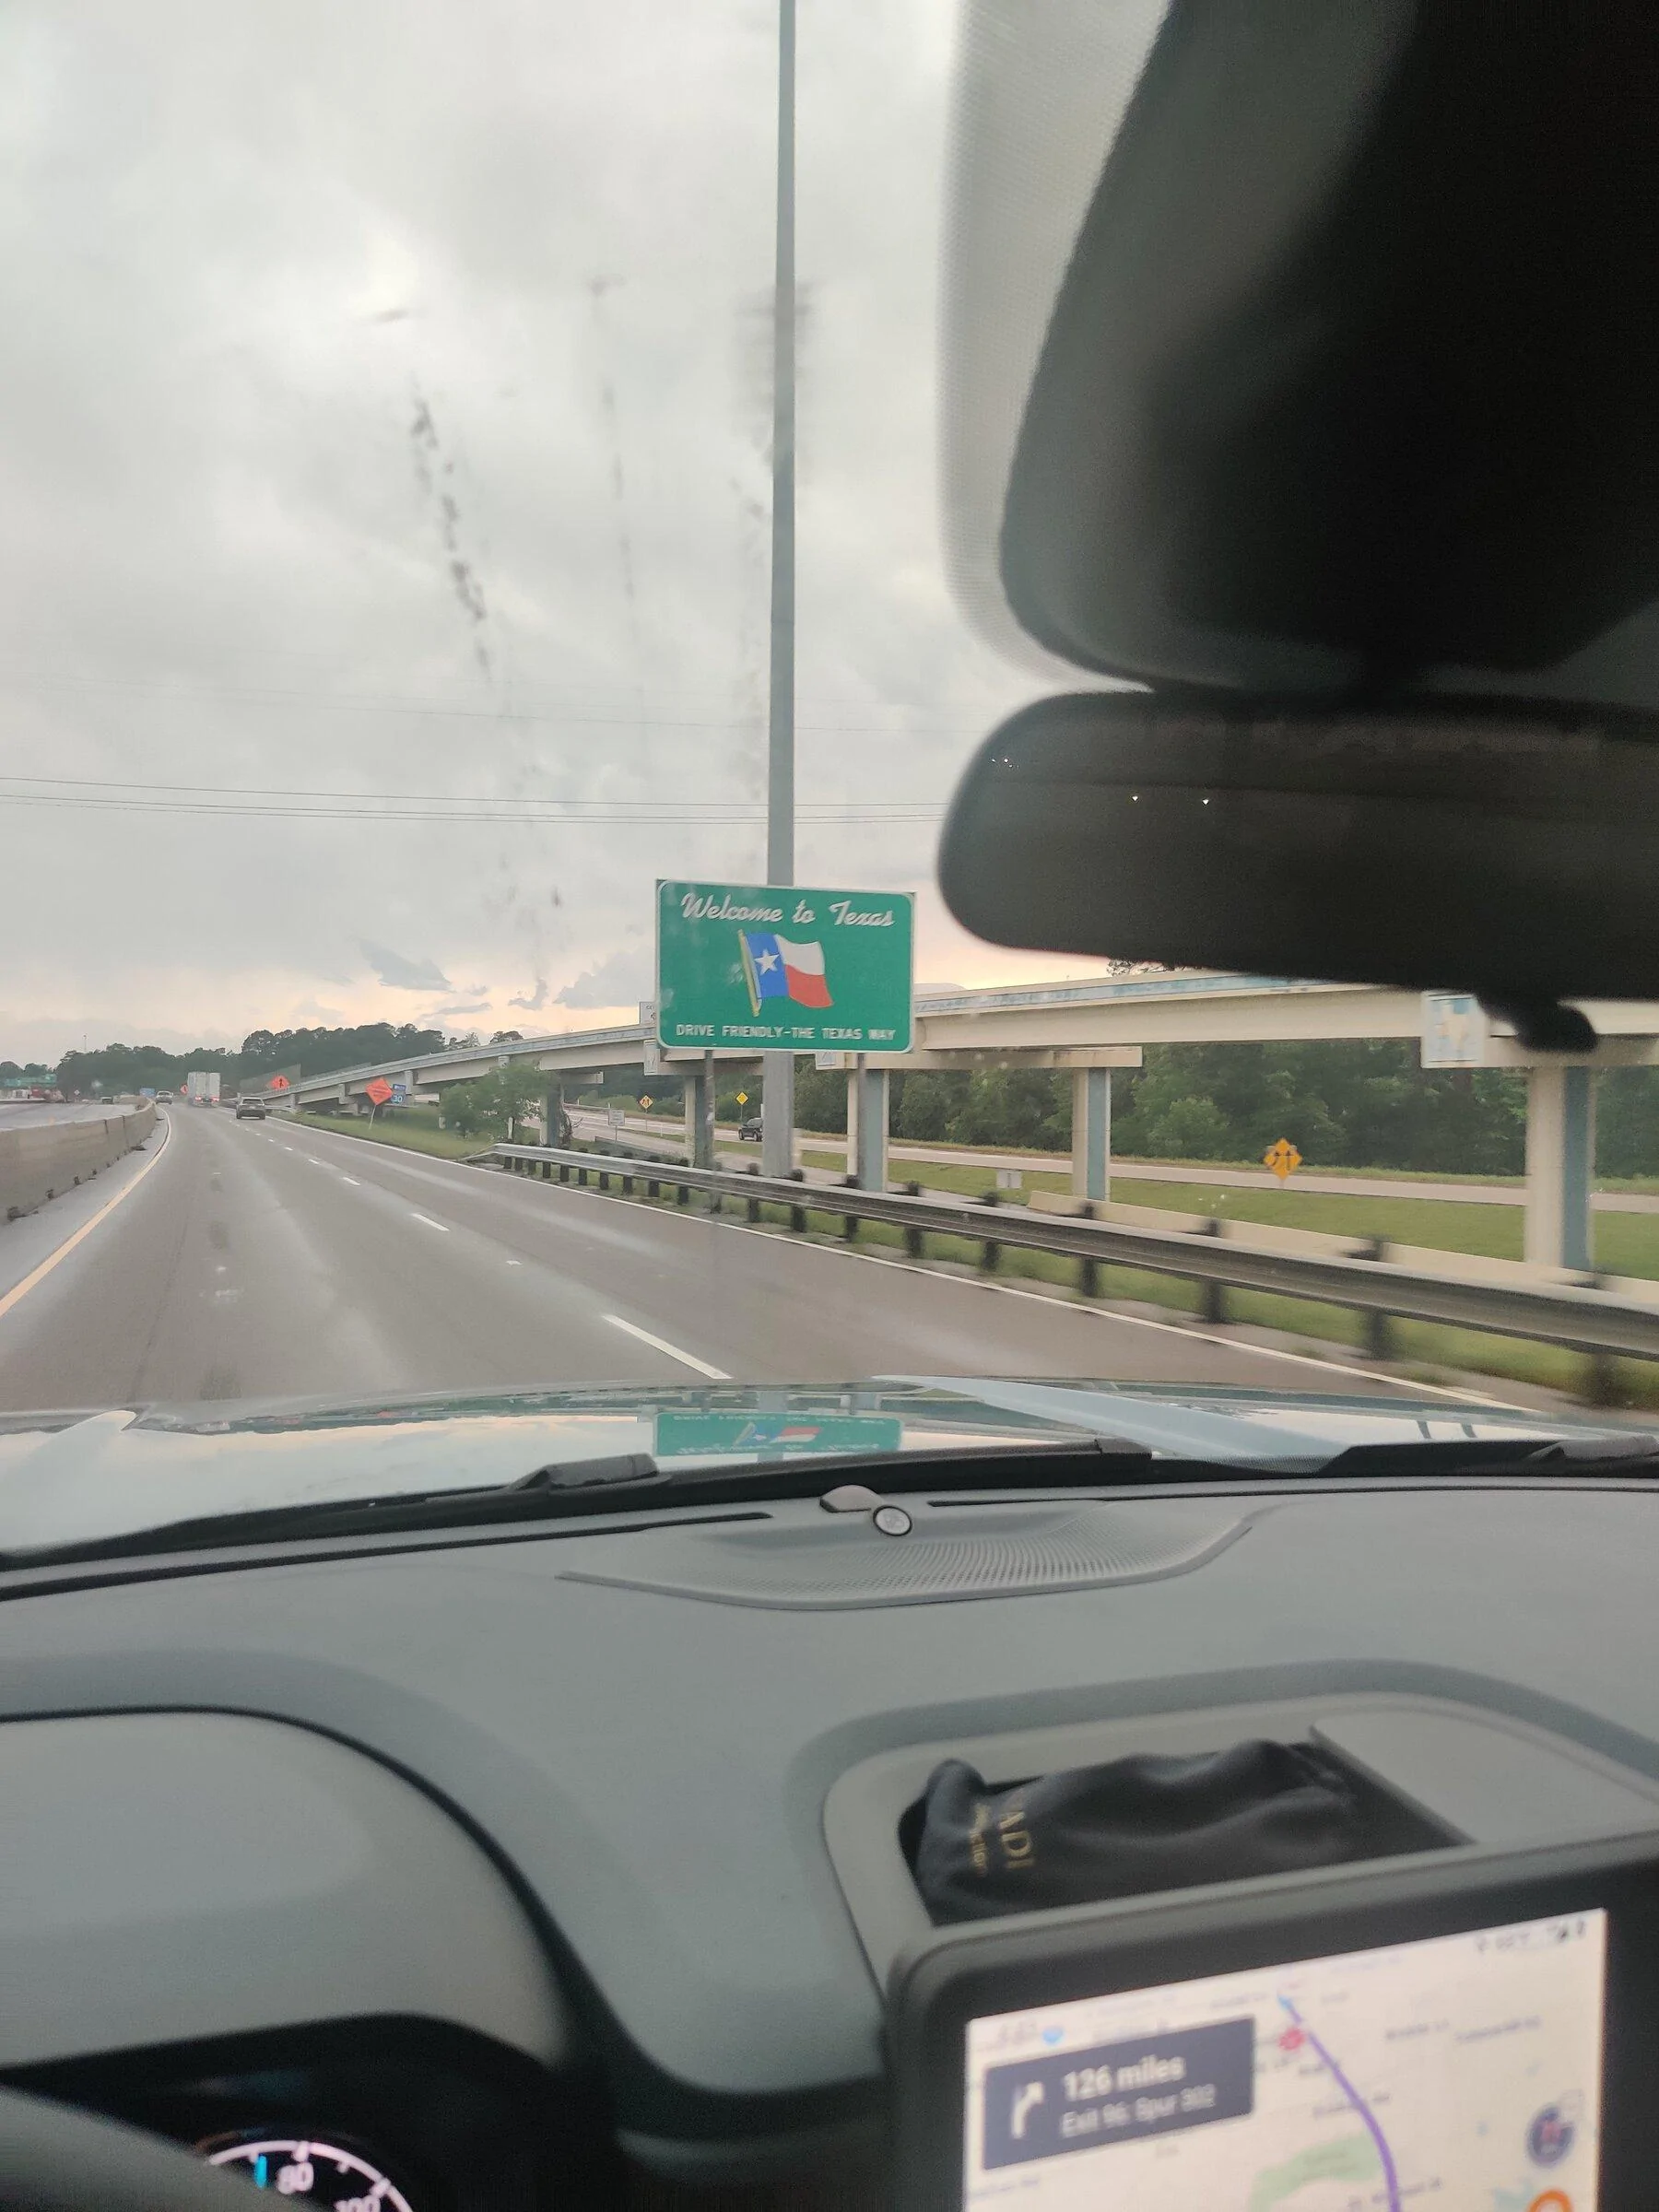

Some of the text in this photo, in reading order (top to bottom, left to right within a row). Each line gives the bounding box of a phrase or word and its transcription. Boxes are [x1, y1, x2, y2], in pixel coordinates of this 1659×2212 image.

[681, 892, 896, 927] Welcome to Texas
[676, 1024, 715, 1037] DRIVE
[821, 1028, 863, 1040] TEXAS
[868, 1029, 896, 1041] WAY
[1064, 2054, 1186, 2101] 126 miles
[277, 2161, 314, 2194] 80
